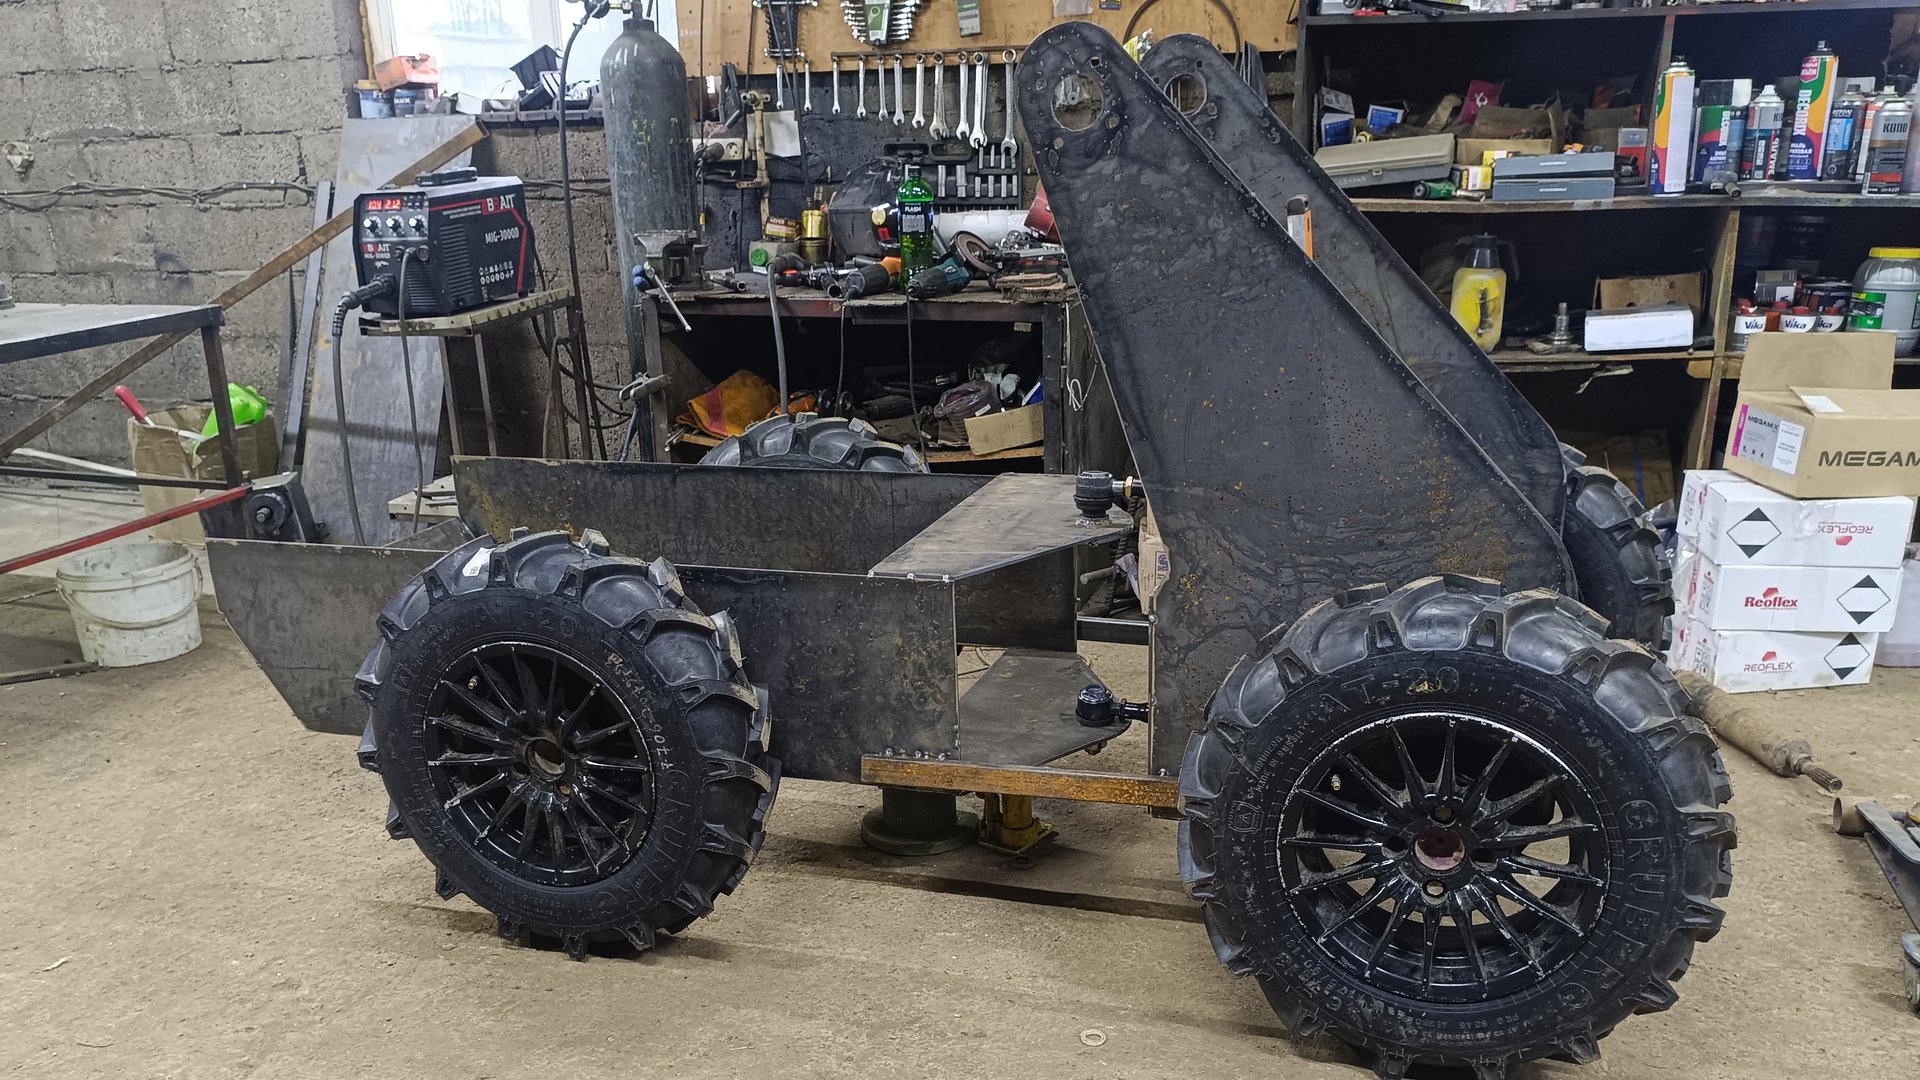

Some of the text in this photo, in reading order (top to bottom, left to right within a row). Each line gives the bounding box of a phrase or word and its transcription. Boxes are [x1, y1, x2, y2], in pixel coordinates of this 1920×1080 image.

[1882, 122, 1909, 134] KUDO
[1744, 319, 1763, 329] Vika
[1785, 318, 1807, 329] Vika
[1817, 317, 1833, 328] ika
[1817, 525, 1874, 534] REOFLEX
[1744, 596, 1798, 607] Reoflex
[1743, 661, 1793, 672] REOFLEX
